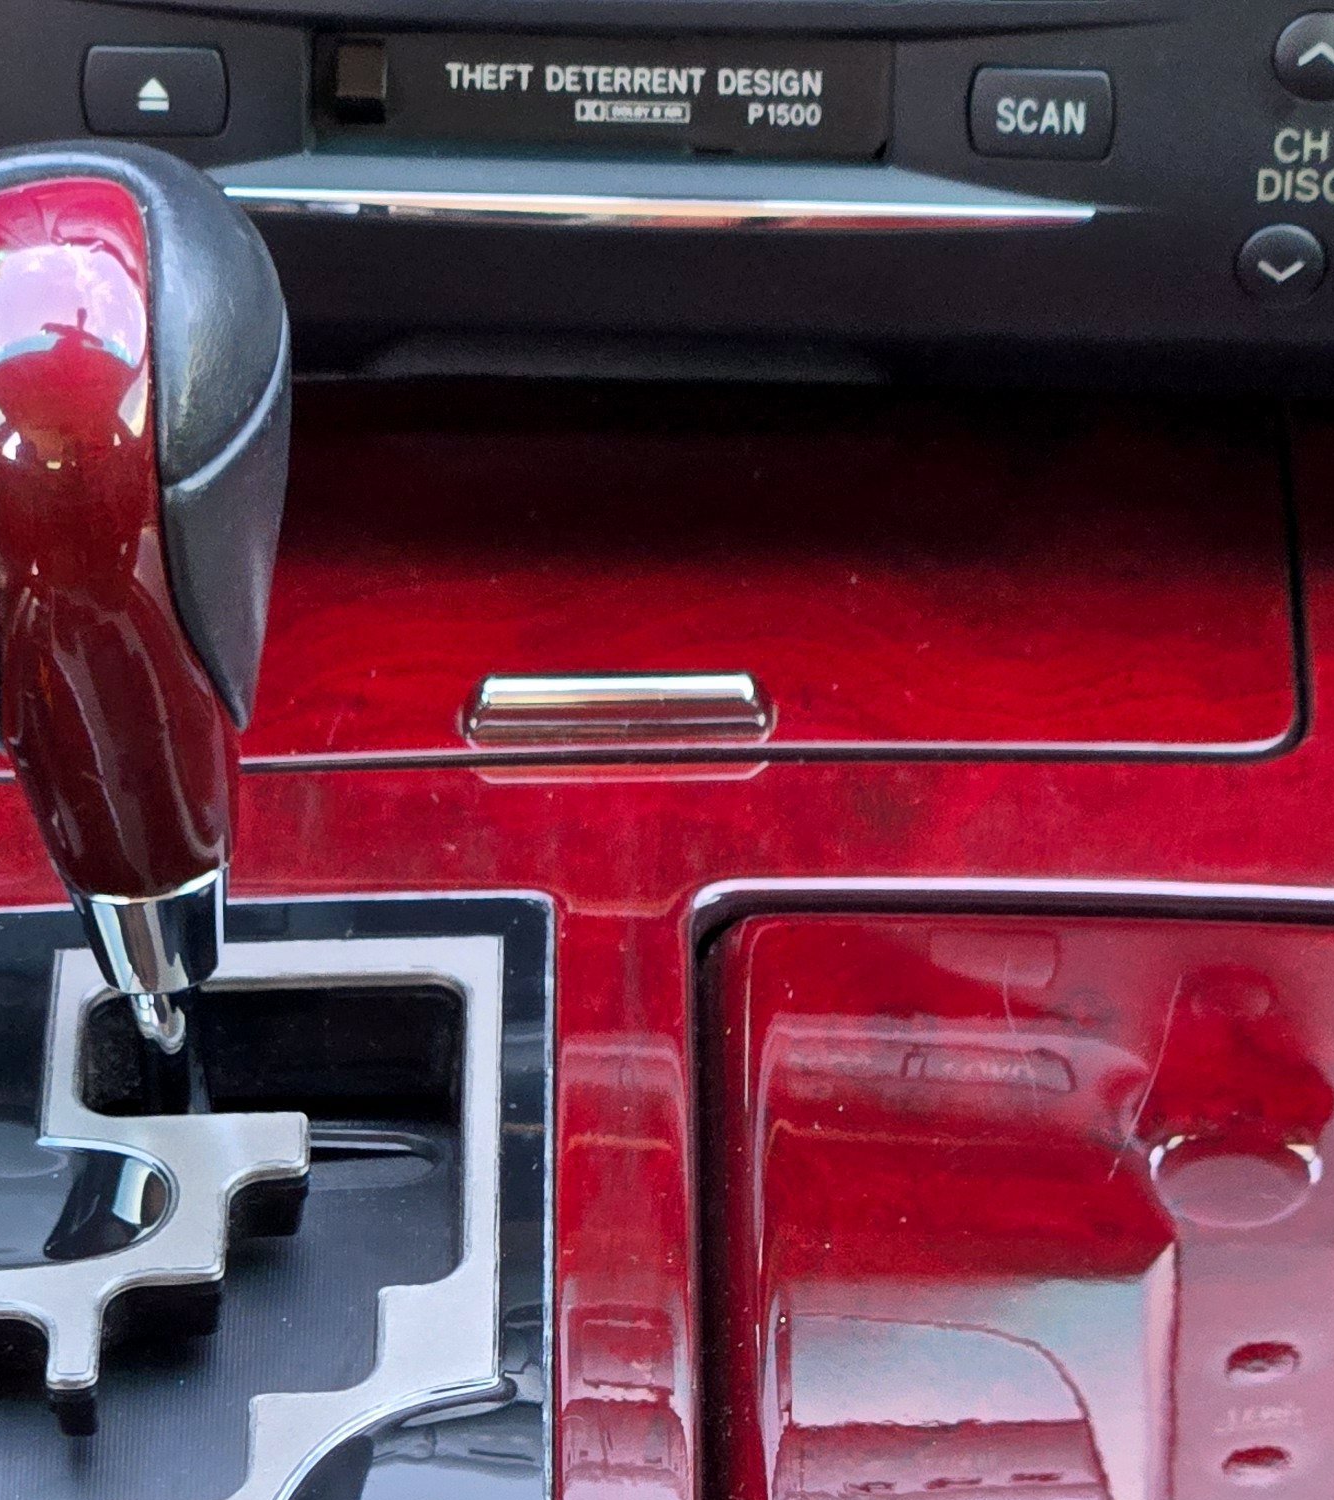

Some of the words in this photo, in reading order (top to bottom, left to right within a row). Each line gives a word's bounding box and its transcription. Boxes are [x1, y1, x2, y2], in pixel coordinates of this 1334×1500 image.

[445, 62, 534, 91] THEFT
[545, 64, 706, 95] DETERRENT
[717, 67, 823, 97] DESIGN
[747, 102, 823, 126] P1500
[995, 97, 1087, 135] SCAN
[1273, 127, 1331, 164] CH
